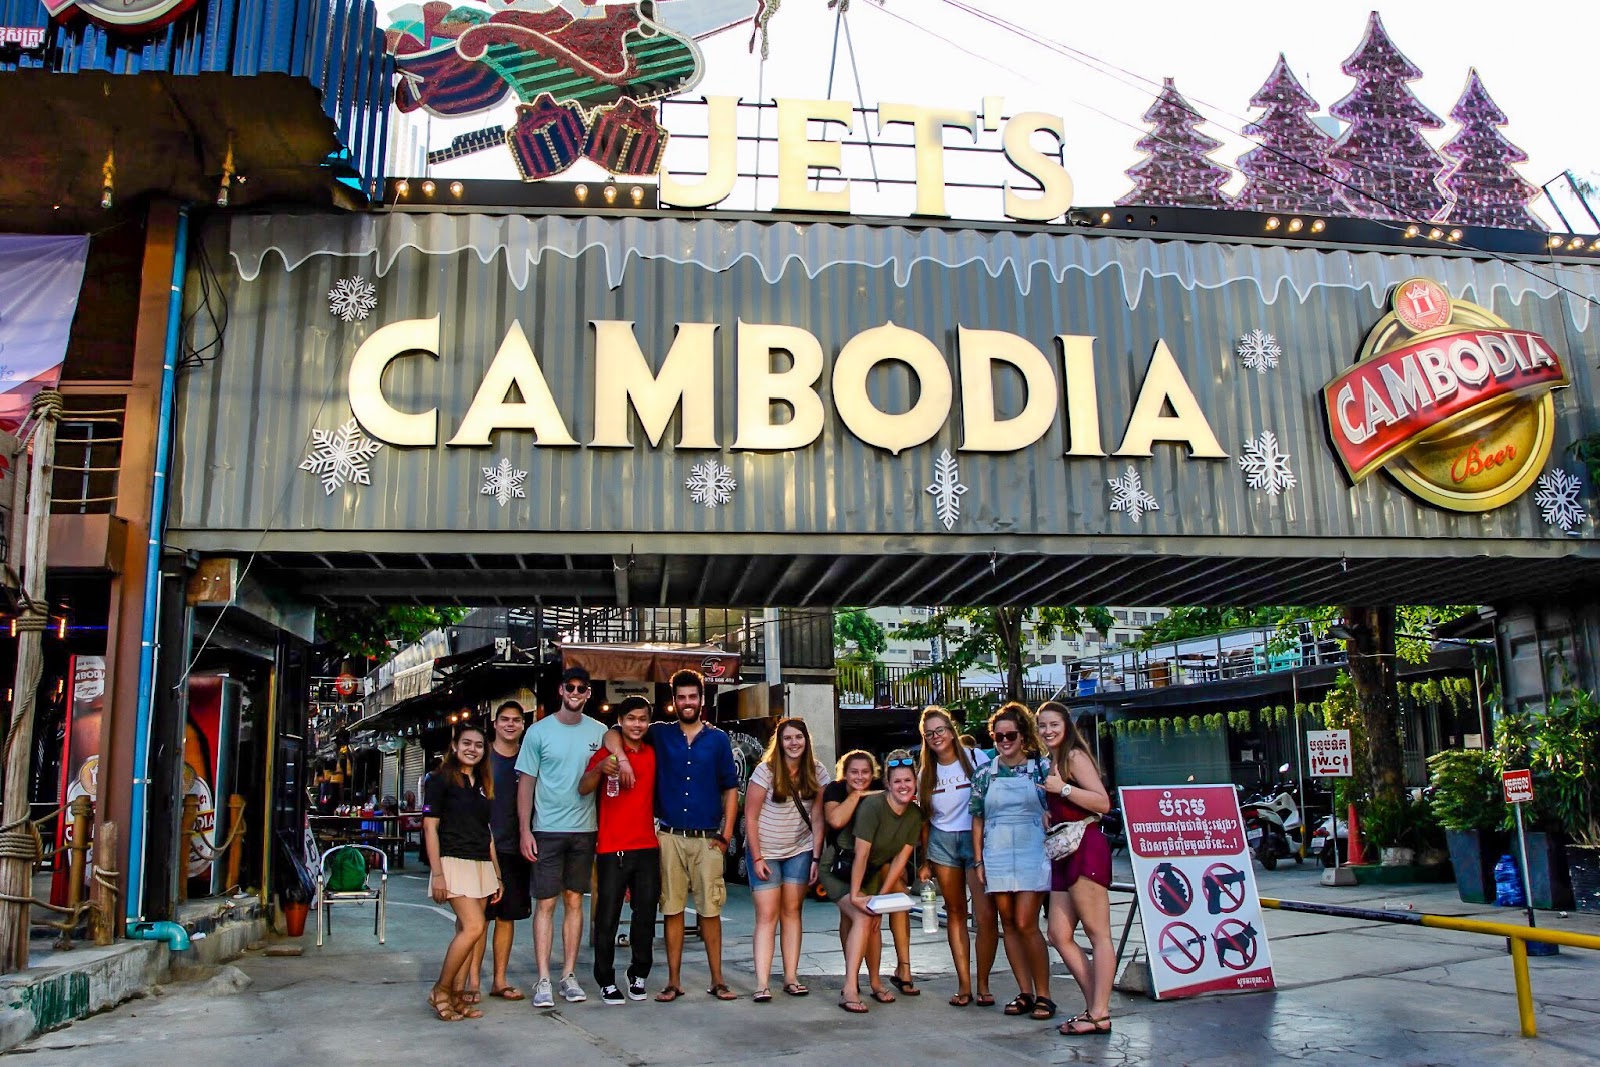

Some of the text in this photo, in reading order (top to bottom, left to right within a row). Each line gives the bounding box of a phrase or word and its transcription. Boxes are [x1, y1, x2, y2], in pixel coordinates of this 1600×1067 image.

[660, 95, 1074, 223] JET'S
[348, 312, 1231, 459] CAMBODIA
[1336, 333, 1557, 445] CAMBODIA
[1450, 439, 1518, 483] Beer
[1309, 733, 1347, 756] បន្ទប់ទឹក
[1316, 755, 1342, 766] W.C
